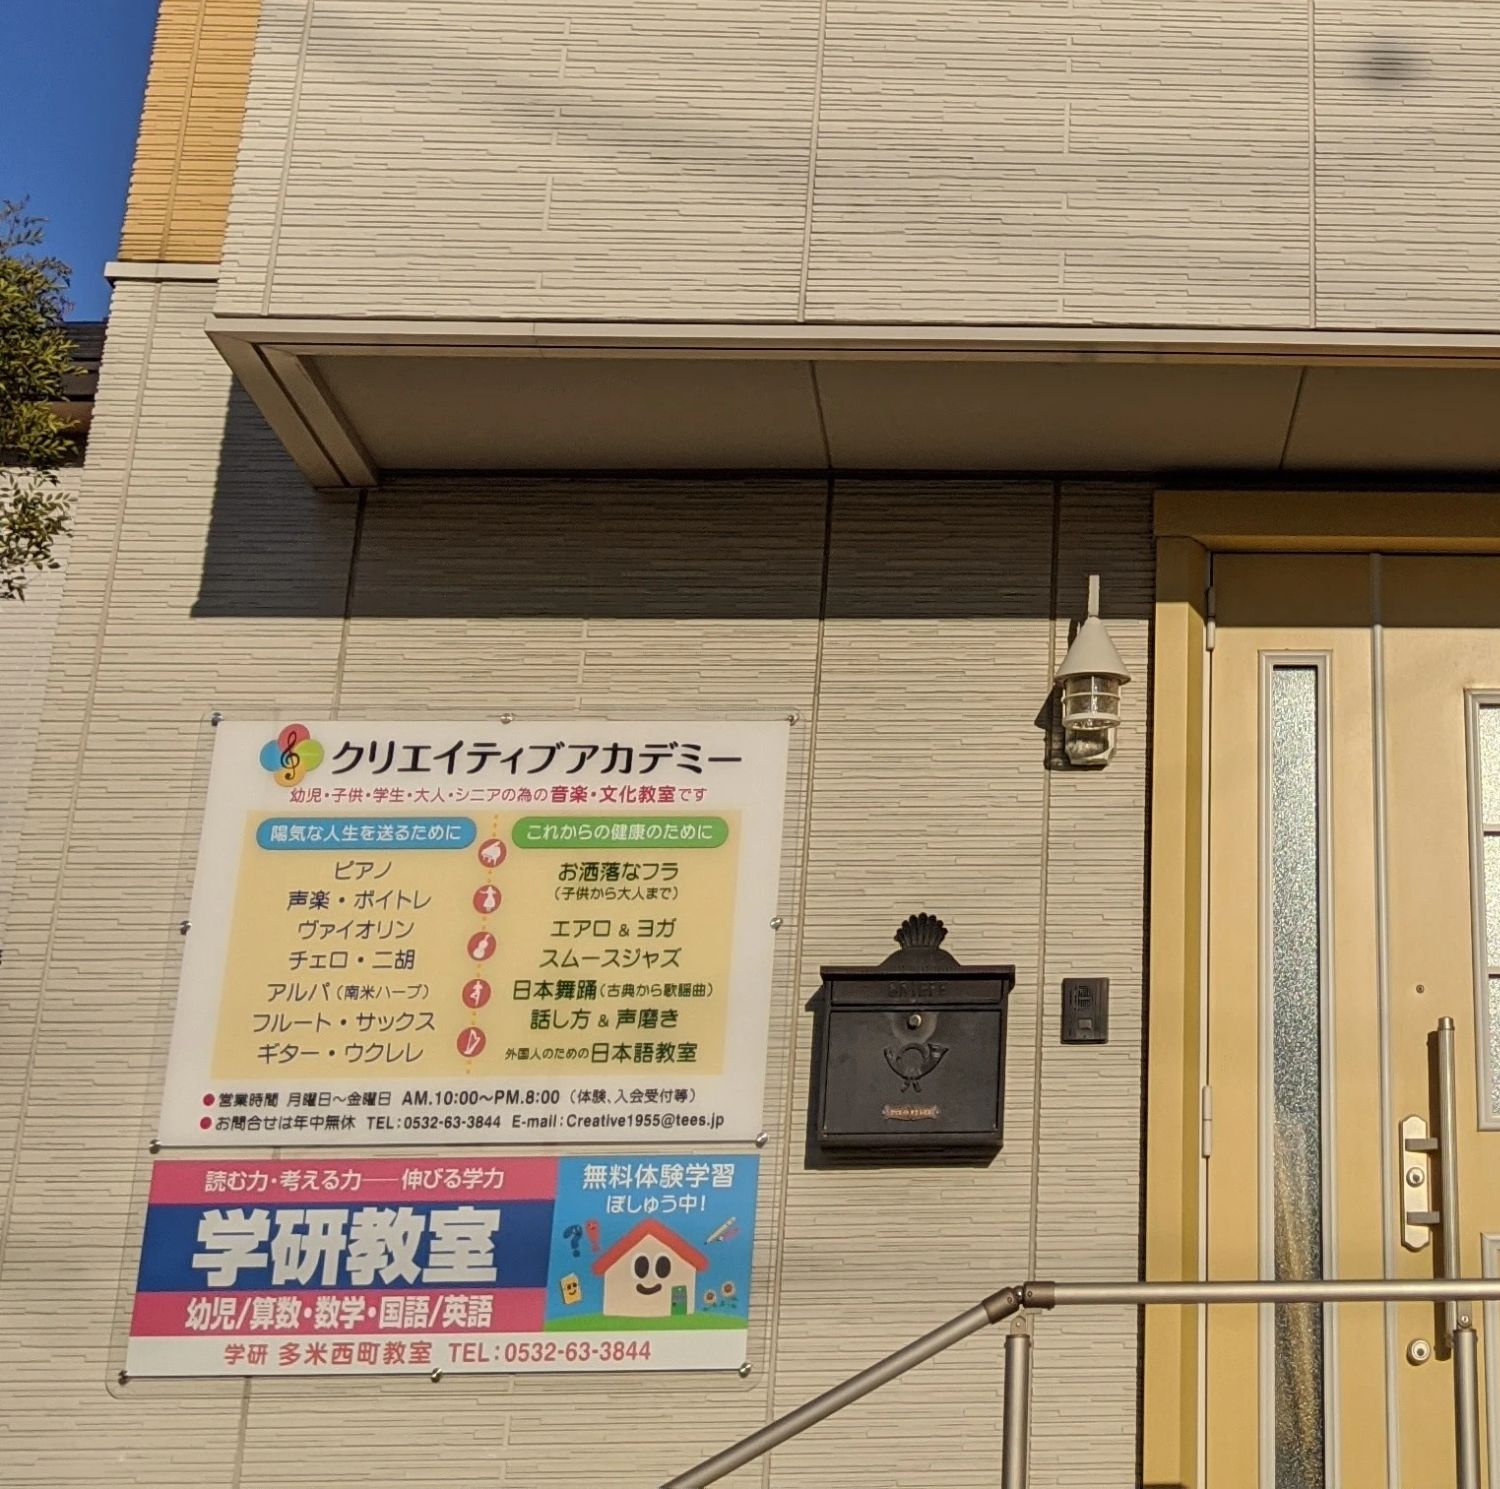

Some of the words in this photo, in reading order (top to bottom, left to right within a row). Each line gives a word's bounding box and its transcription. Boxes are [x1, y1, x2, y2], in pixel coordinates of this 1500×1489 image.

[331, 740, 742, 775] クリエイティブアカデミー
[270, 824, 461, 842] 陽気な人生を送るために
[526, 823, 713, 841] これからの健康のために
[335, 861, 392, 880] ピアノ
[558, 862, 679, 882] お洒落なフラ
[298, 919, 415, 940] ヴァイオリン
[539, 947, 682, 968] スムースジャズ
[218, 1092, 279, 1108] 営業時間
[215, 1115, 356, 1132] お問合せは年中無休
[583, 1163, 735, 1189] 無料体験学習
[192, 1206, 501, 1287] 学研教室
[224, 1343, 268, 1365] 学研
[278, 1341, 432, 1366] 多米西町教室
